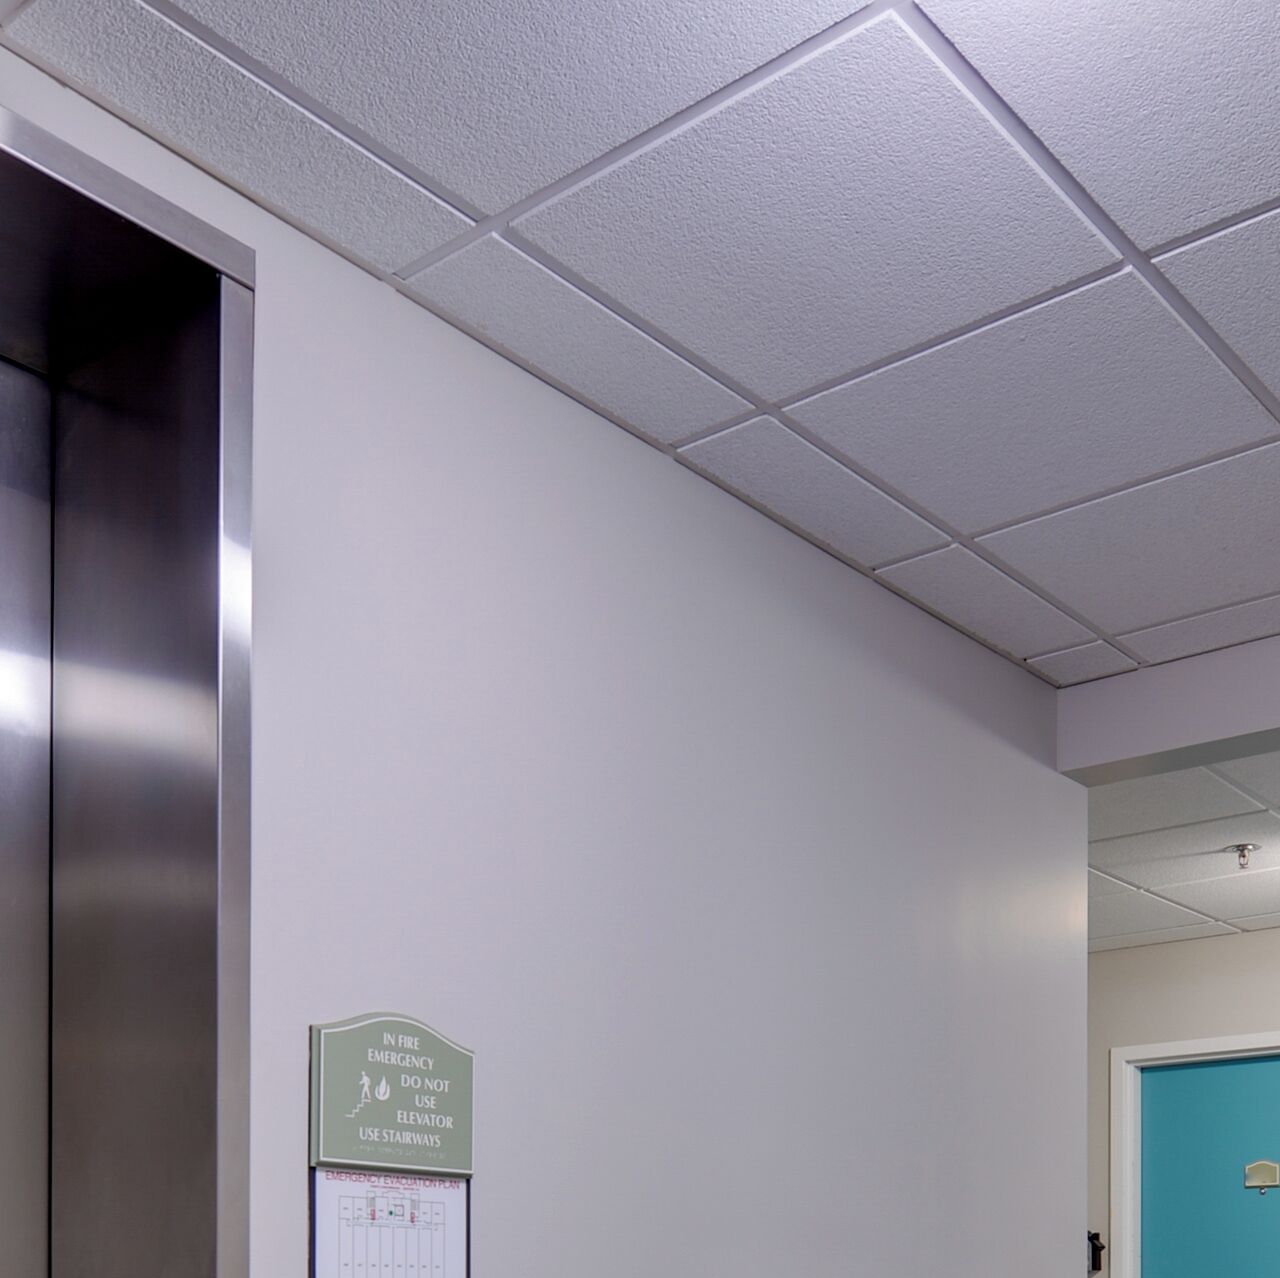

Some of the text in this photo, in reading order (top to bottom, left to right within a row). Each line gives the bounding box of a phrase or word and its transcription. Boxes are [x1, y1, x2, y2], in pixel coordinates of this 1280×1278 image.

[383, 1032, 420, 1050] IN FIRE
[368, 1048, 434, 1070] EMERGENCY
[401, 1074, 450, 1093] DO NOT
[415, 1094, 437, 1109] USE
[397, 1110, 453, 1129] ELEVATOR
[359, 1126, 441, 1148] USE STAIRWAYS
[325, 1170, 460, 1190] EMERGENCY EVACUATION PLAN
